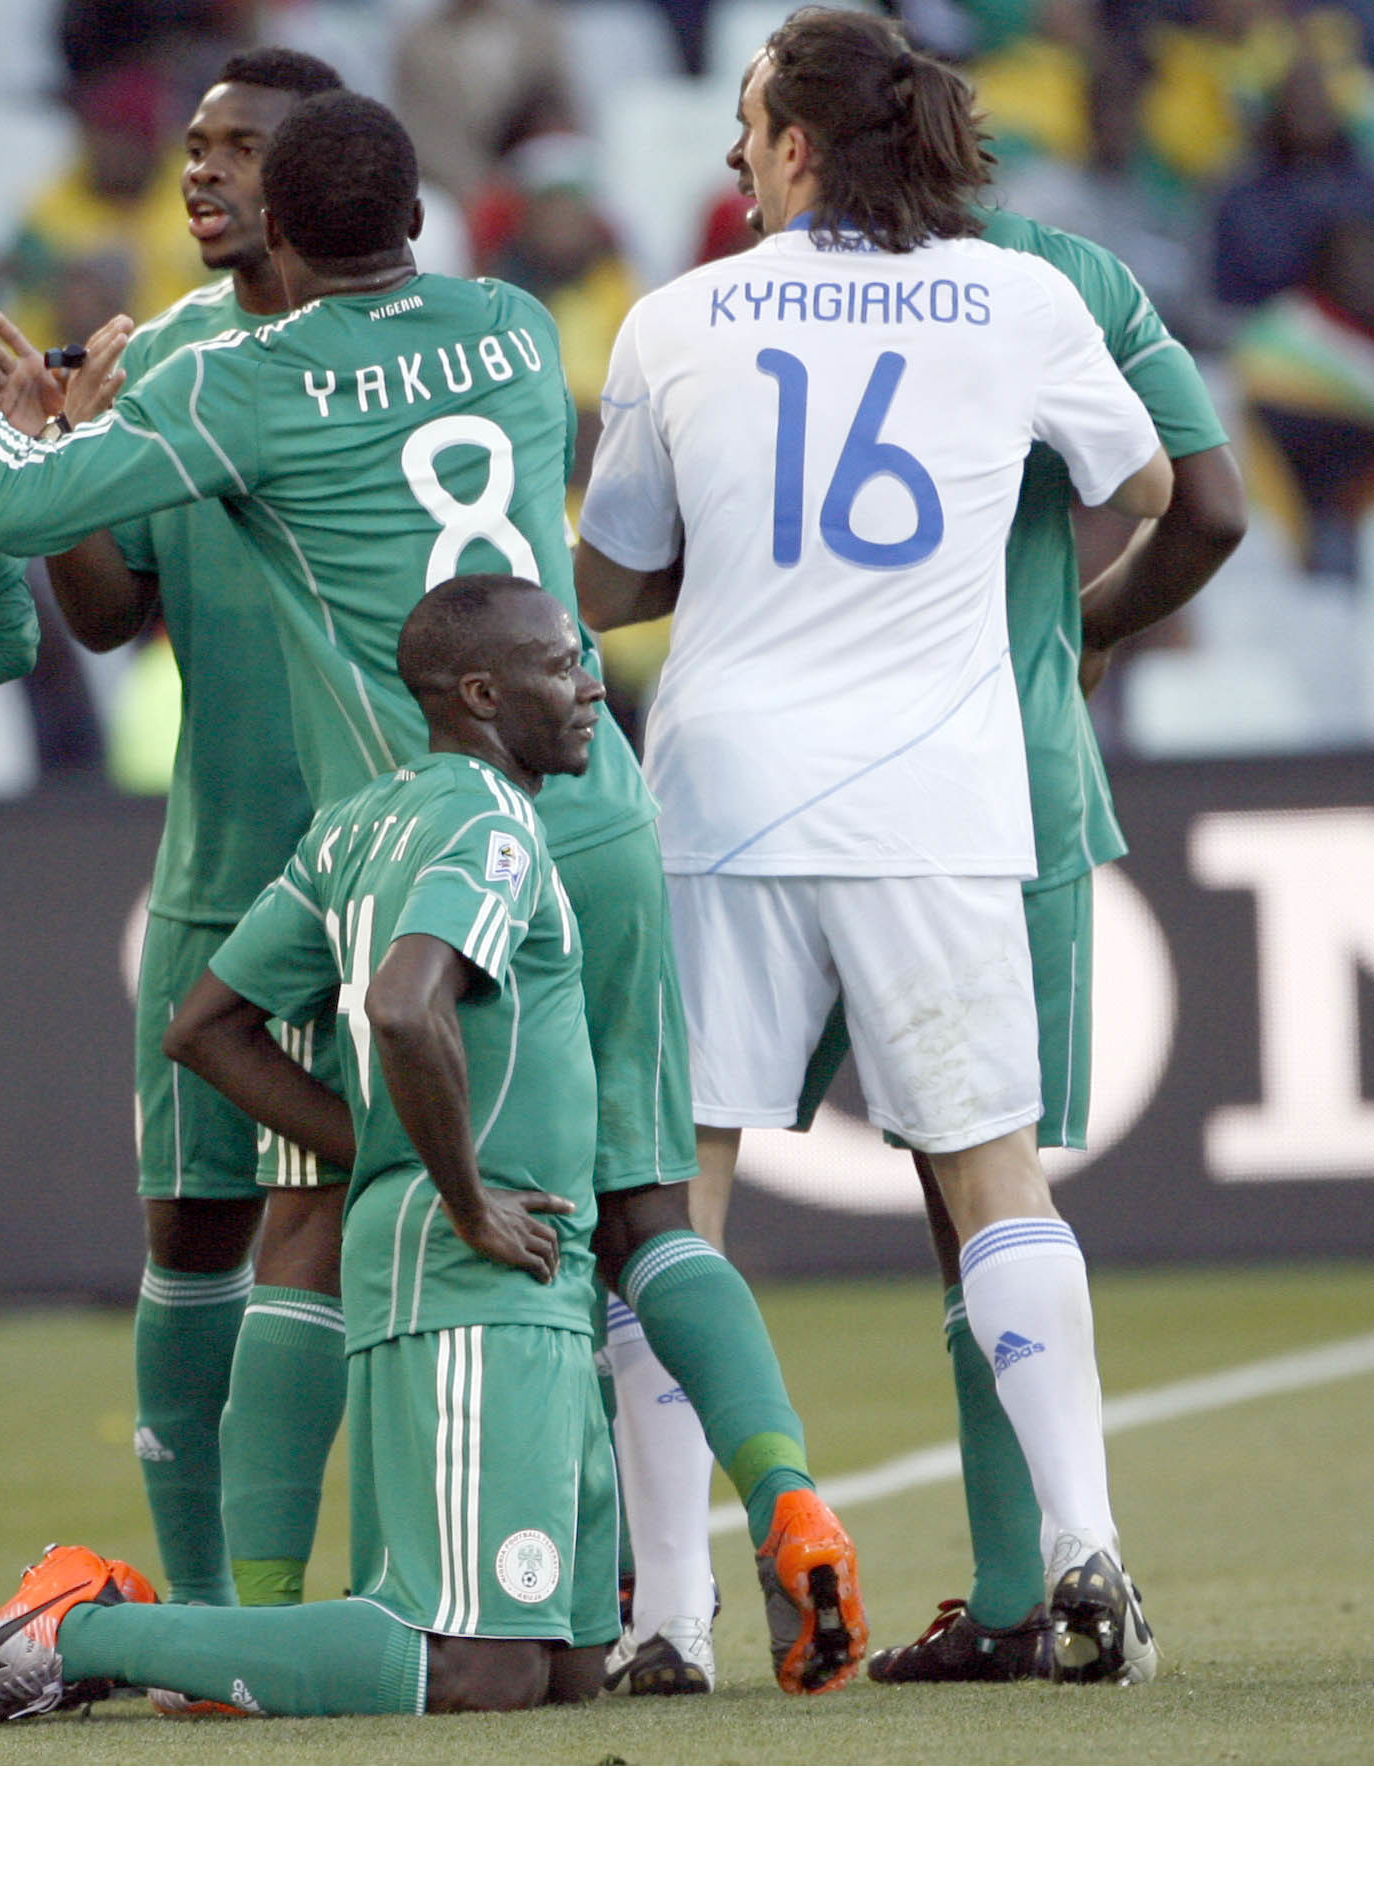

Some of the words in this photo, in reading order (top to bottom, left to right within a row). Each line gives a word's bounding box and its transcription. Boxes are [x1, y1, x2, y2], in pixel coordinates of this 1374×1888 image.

[369, 295, 424, 322] NIGERIA
[710, 279, 992, 327] KYRGIAKOS
[304, 328, 542, 417] YAKUBU
[401, 414, 540, 592] 8
[756, 347, 945, 572] 16
